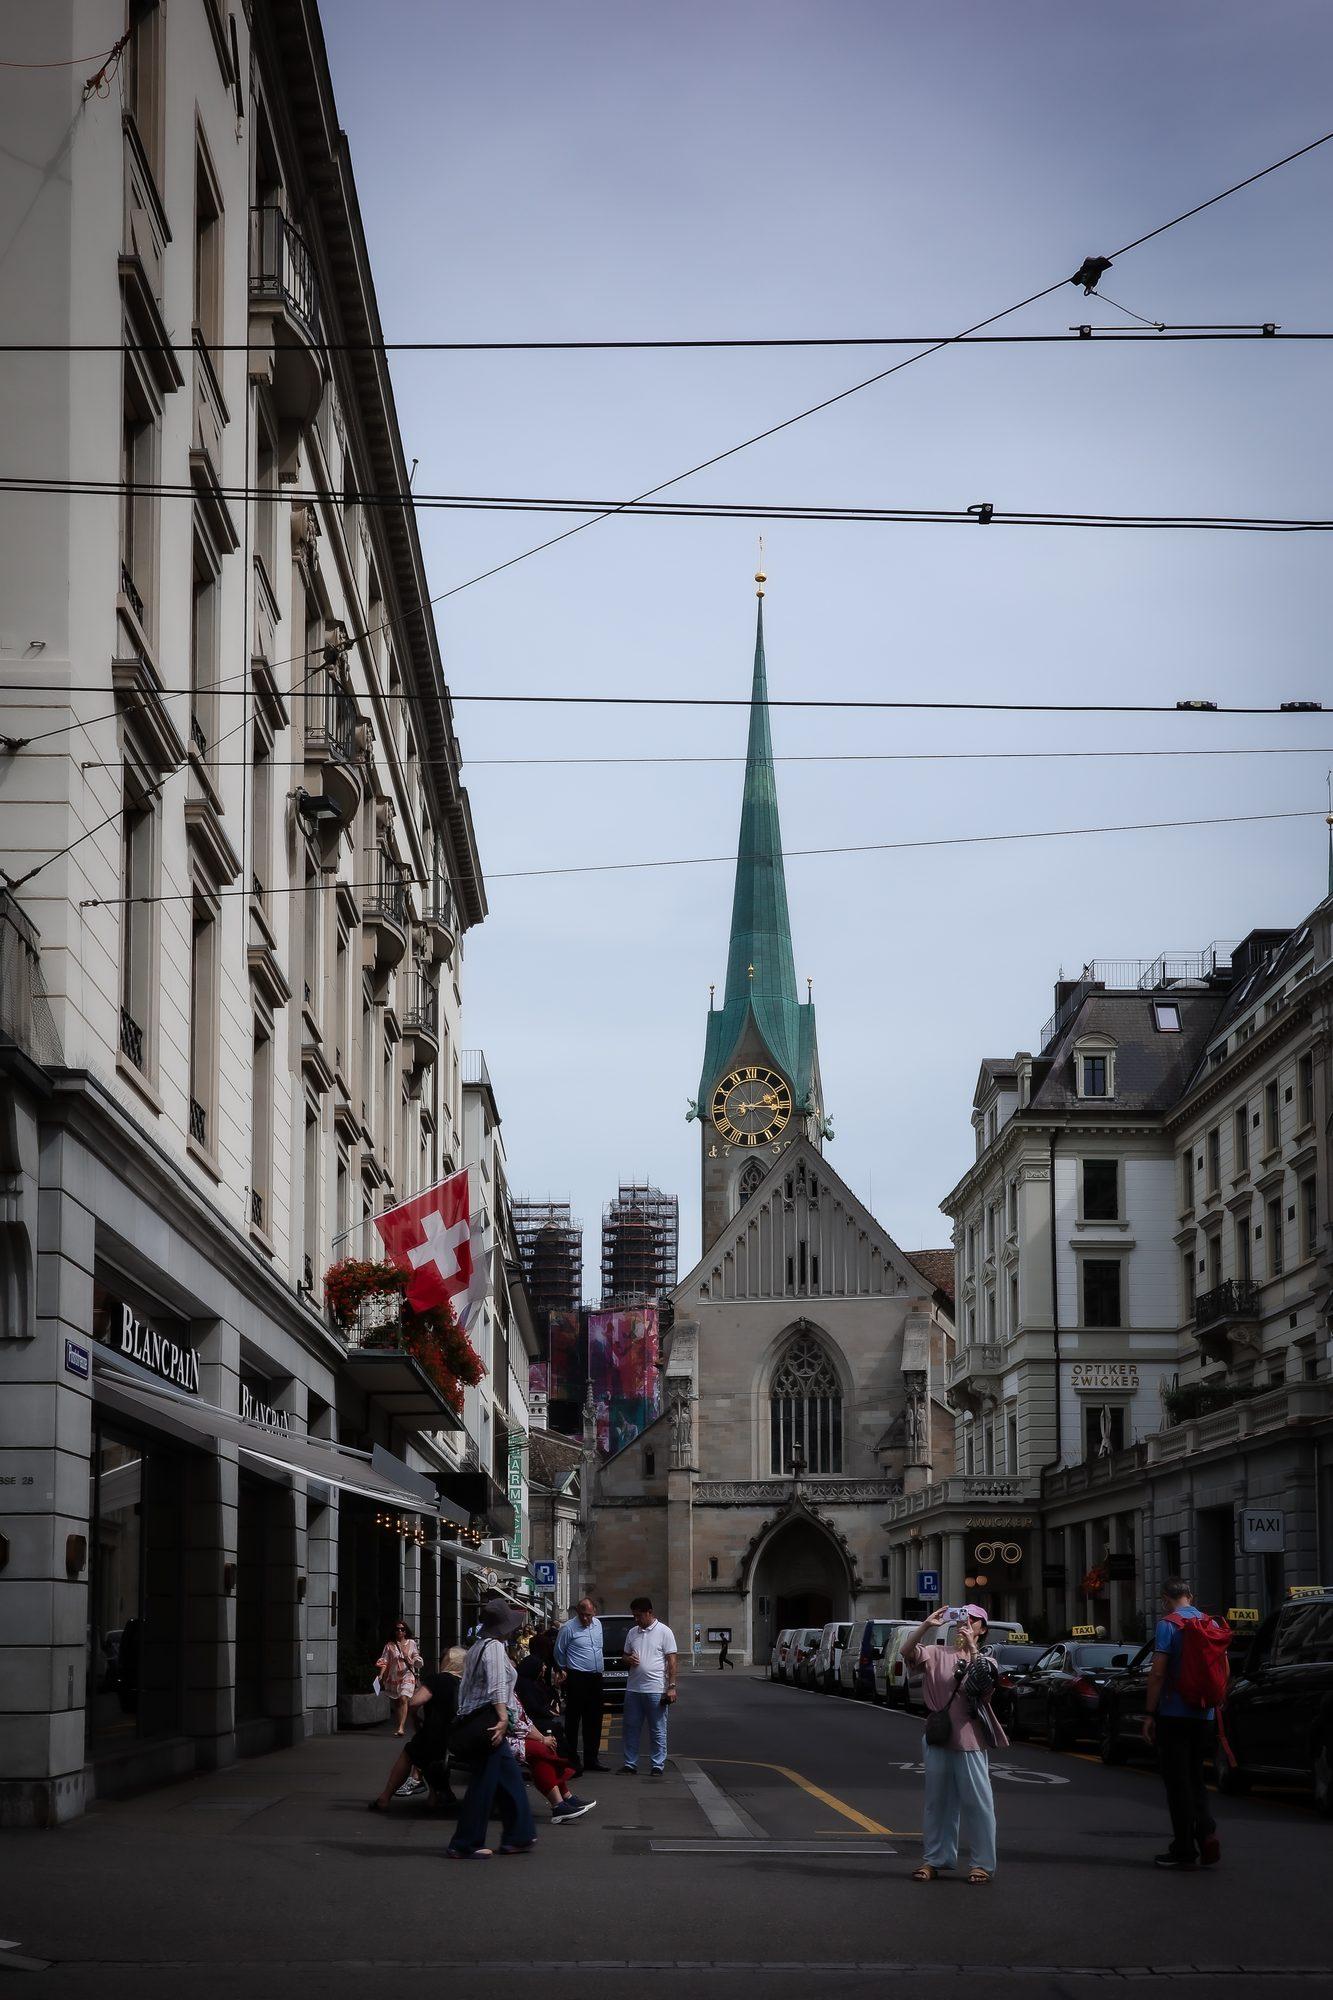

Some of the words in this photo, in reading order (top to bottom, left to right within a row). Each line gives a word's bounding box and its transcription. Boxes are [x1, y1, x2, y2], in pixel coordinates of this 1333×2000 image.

[729, 1073, 741, 1085] XI
[746, 1068, 757, 1079] XII
[717, 1087, 729, 1096] X
[120, 1302, 201, 1393] BLANCPAIN
[1073, 1364, 1137, 1375] OPTIKER
[1071, 1376, 1140, 1386] ZWICKER
[22, 1476, 34, 1485] 28
[1247, 1518, 1280, 1532] TAXI
[923, 1575, 933, 1590] P
[1232, 1610, 1255, 1620] TAXI
[1074, 1626, 1094, 1634] TAXI
